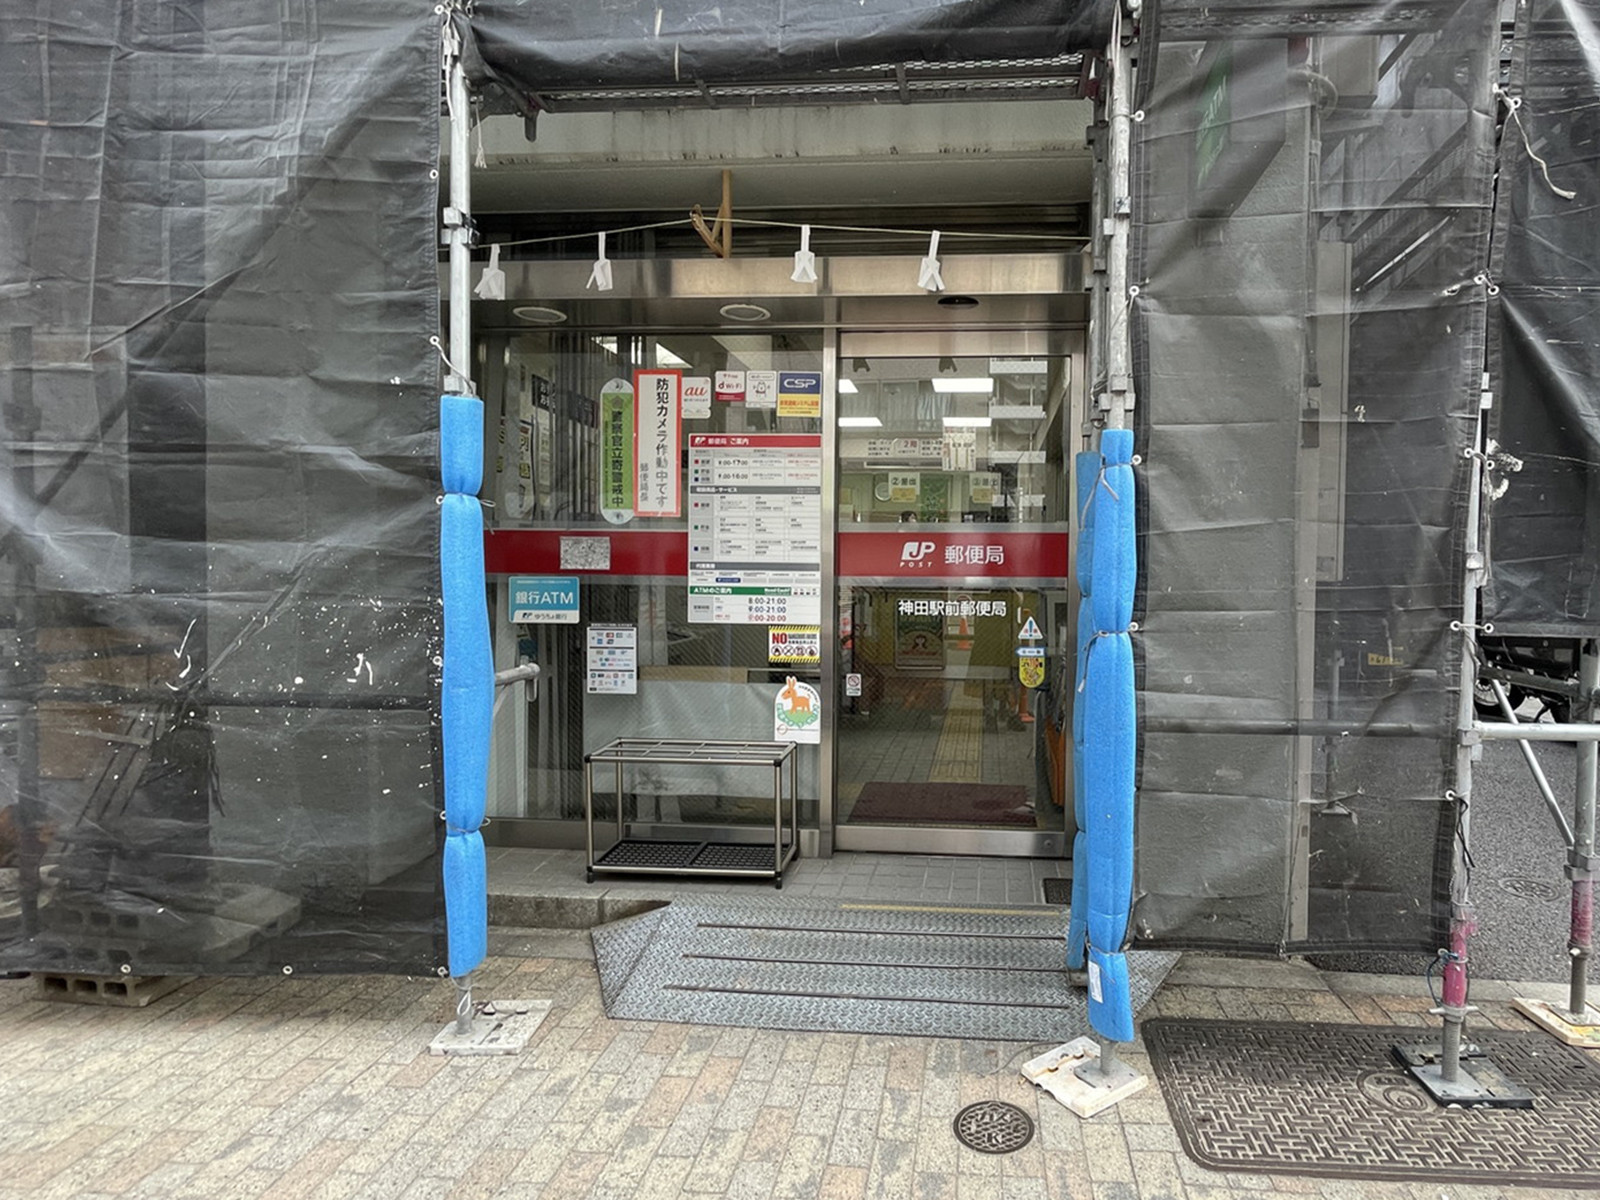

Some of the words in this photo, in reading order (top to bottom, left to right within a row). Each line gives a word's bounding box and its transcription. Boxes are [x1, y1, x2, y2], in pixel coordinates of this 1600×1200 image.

[684, 386, 708, 396] au
[783, 379, 816, 389] CSP
[655, 378, 669, 508] 防犯カメラ作動中です
[611, 410, 624, 507] 警察官立寄警戒中
[901, 541, 936, 561] JP
[944, 545, 1004, 565] 郵便局
[515, 591, 573, 604] 銀行ATM
[898, 600, 1007, 617] 神田駅前郵便局
[772, 632, 787, 645] NO
